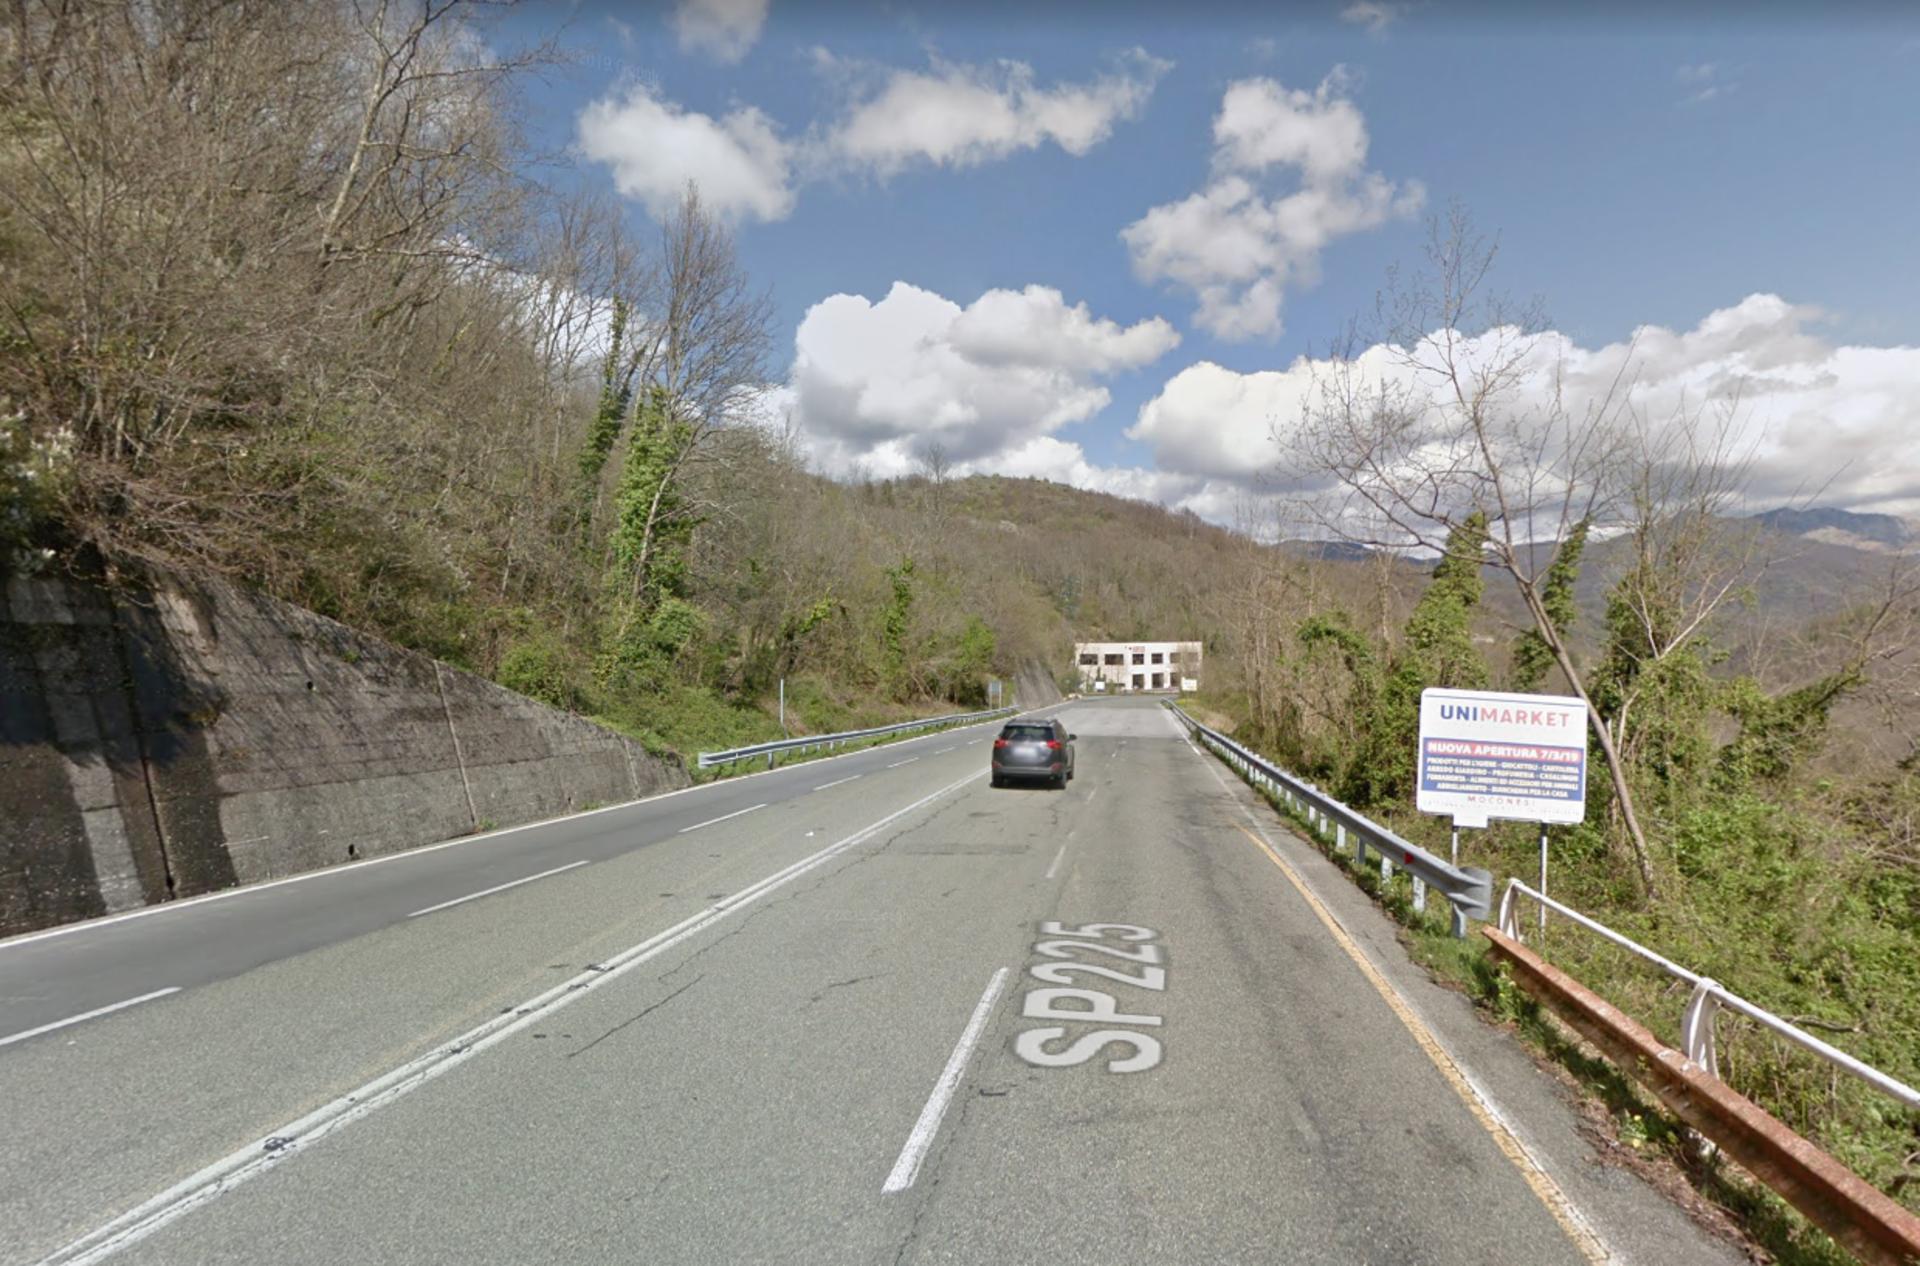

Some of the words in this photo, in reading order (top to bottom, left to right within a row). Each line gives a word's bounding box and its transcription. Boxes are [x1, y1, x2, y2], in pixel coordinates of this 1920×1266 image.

[1440, 704, 1570, 727] UNIMARKET
[1426, 741, 1472, 754] NUOVA
[1474, 745, 1538, 759] APERTURA
